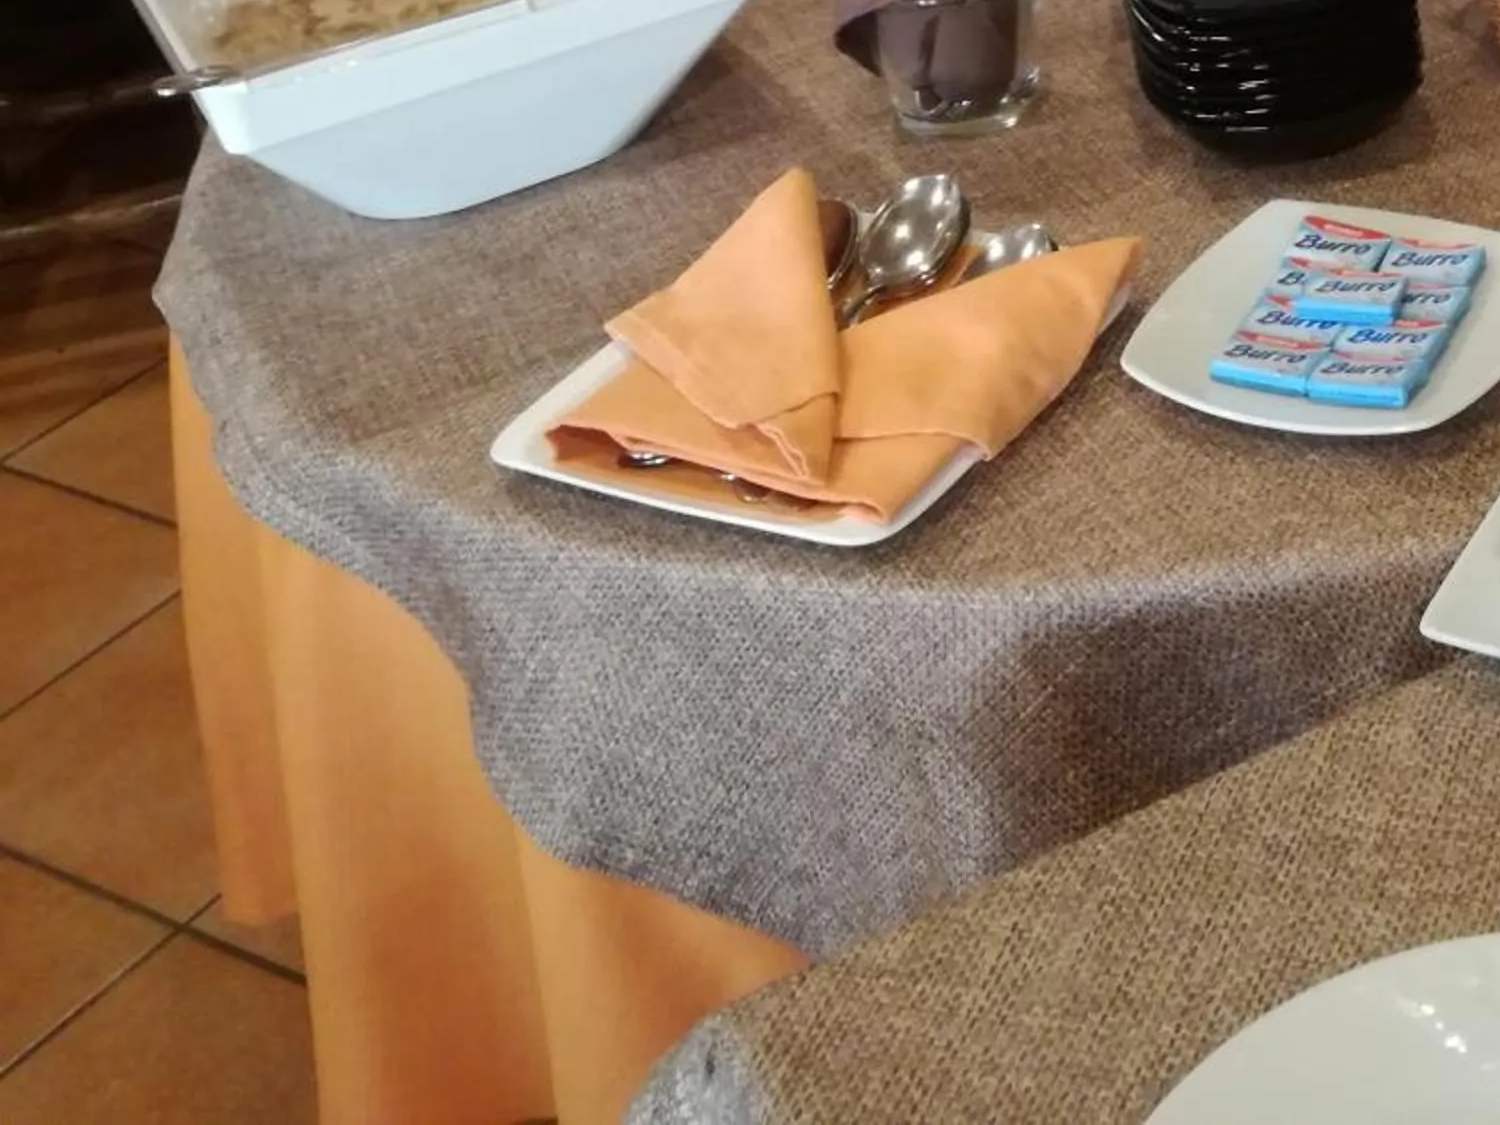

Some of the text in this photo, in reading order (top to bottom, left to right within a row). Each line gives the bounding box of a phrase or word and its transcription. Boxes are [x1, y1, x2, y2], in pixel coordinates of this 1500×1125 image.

[1294, 233, 1372, 256] Burro
[1391, 251, 1470, 268] Burro
[1315, 278, 1396, 294] Burro
[1257, 309, 1342, 331] Burro
[1346, 328, 1429, 345] Burro
[1222, 343, 1307, 364] Burro
[1320, 361, 1404, 376] Burro
